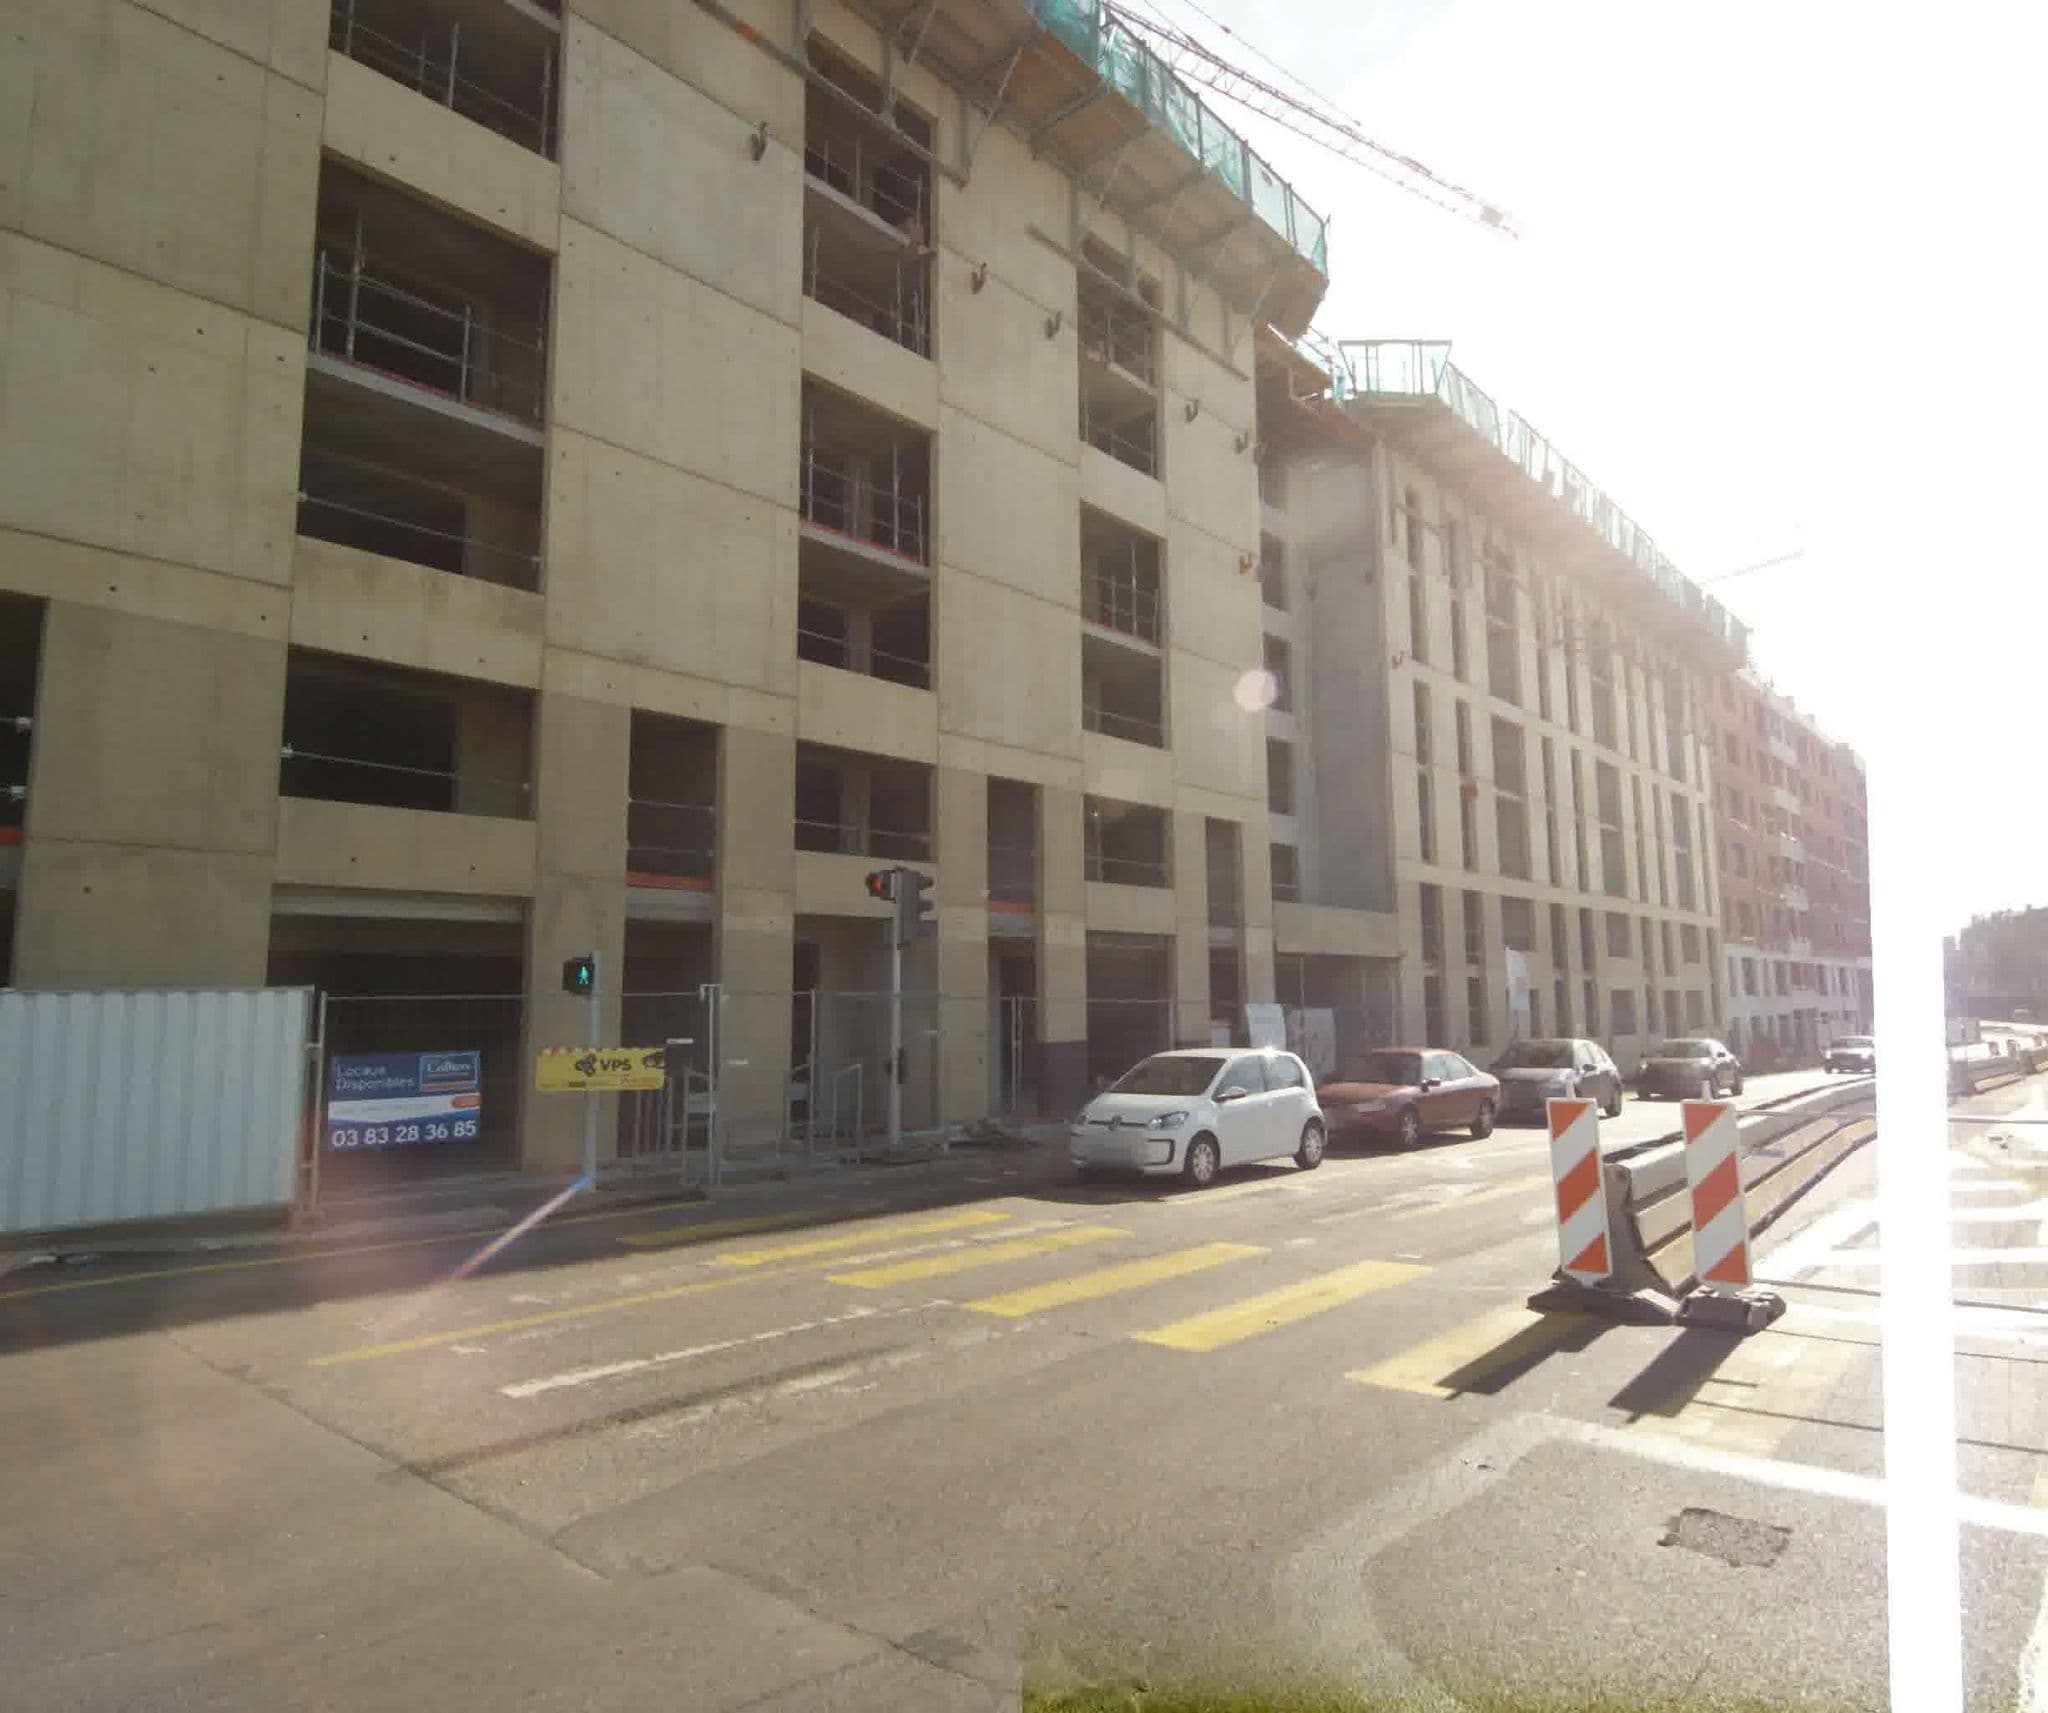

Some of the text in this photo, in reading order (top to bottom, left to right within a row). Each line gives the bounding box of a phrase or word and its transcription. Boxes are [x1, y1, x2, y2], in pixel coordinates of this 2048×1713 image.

[600, 1057, 632, 1071] VPS
[332, 1120, 476, 1147] 03 83 28 36 85
